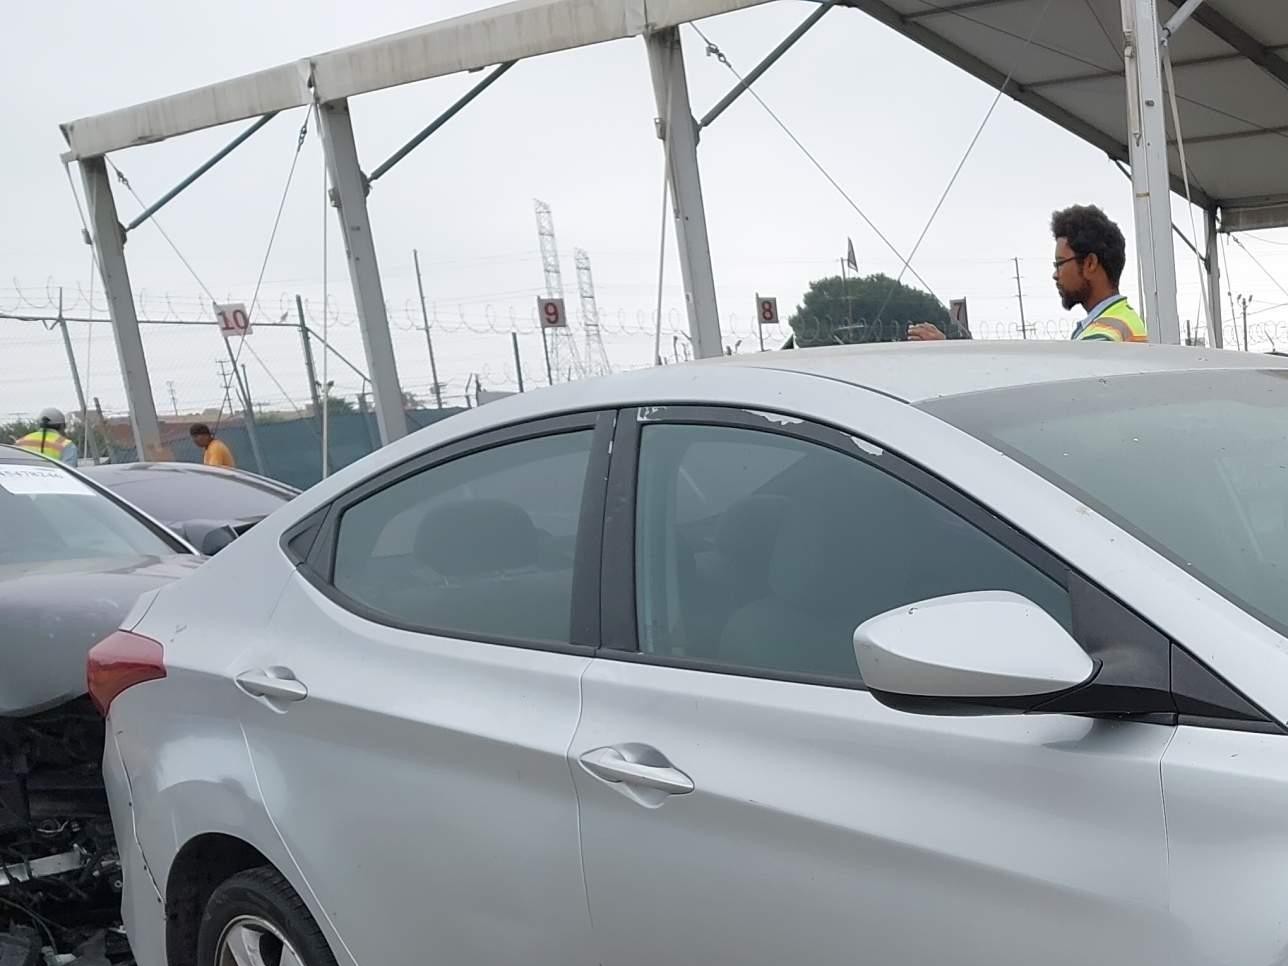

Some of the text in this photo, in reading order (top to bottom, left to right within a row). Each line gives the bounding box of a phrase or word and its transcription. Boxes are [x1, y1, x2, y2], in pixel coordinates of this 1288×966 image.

[217, 309, 249, 330] 10
[544, 302, 559, 324] 9
[761, 300, 773, 320] 8
[953, 302, 963, 320] 7
